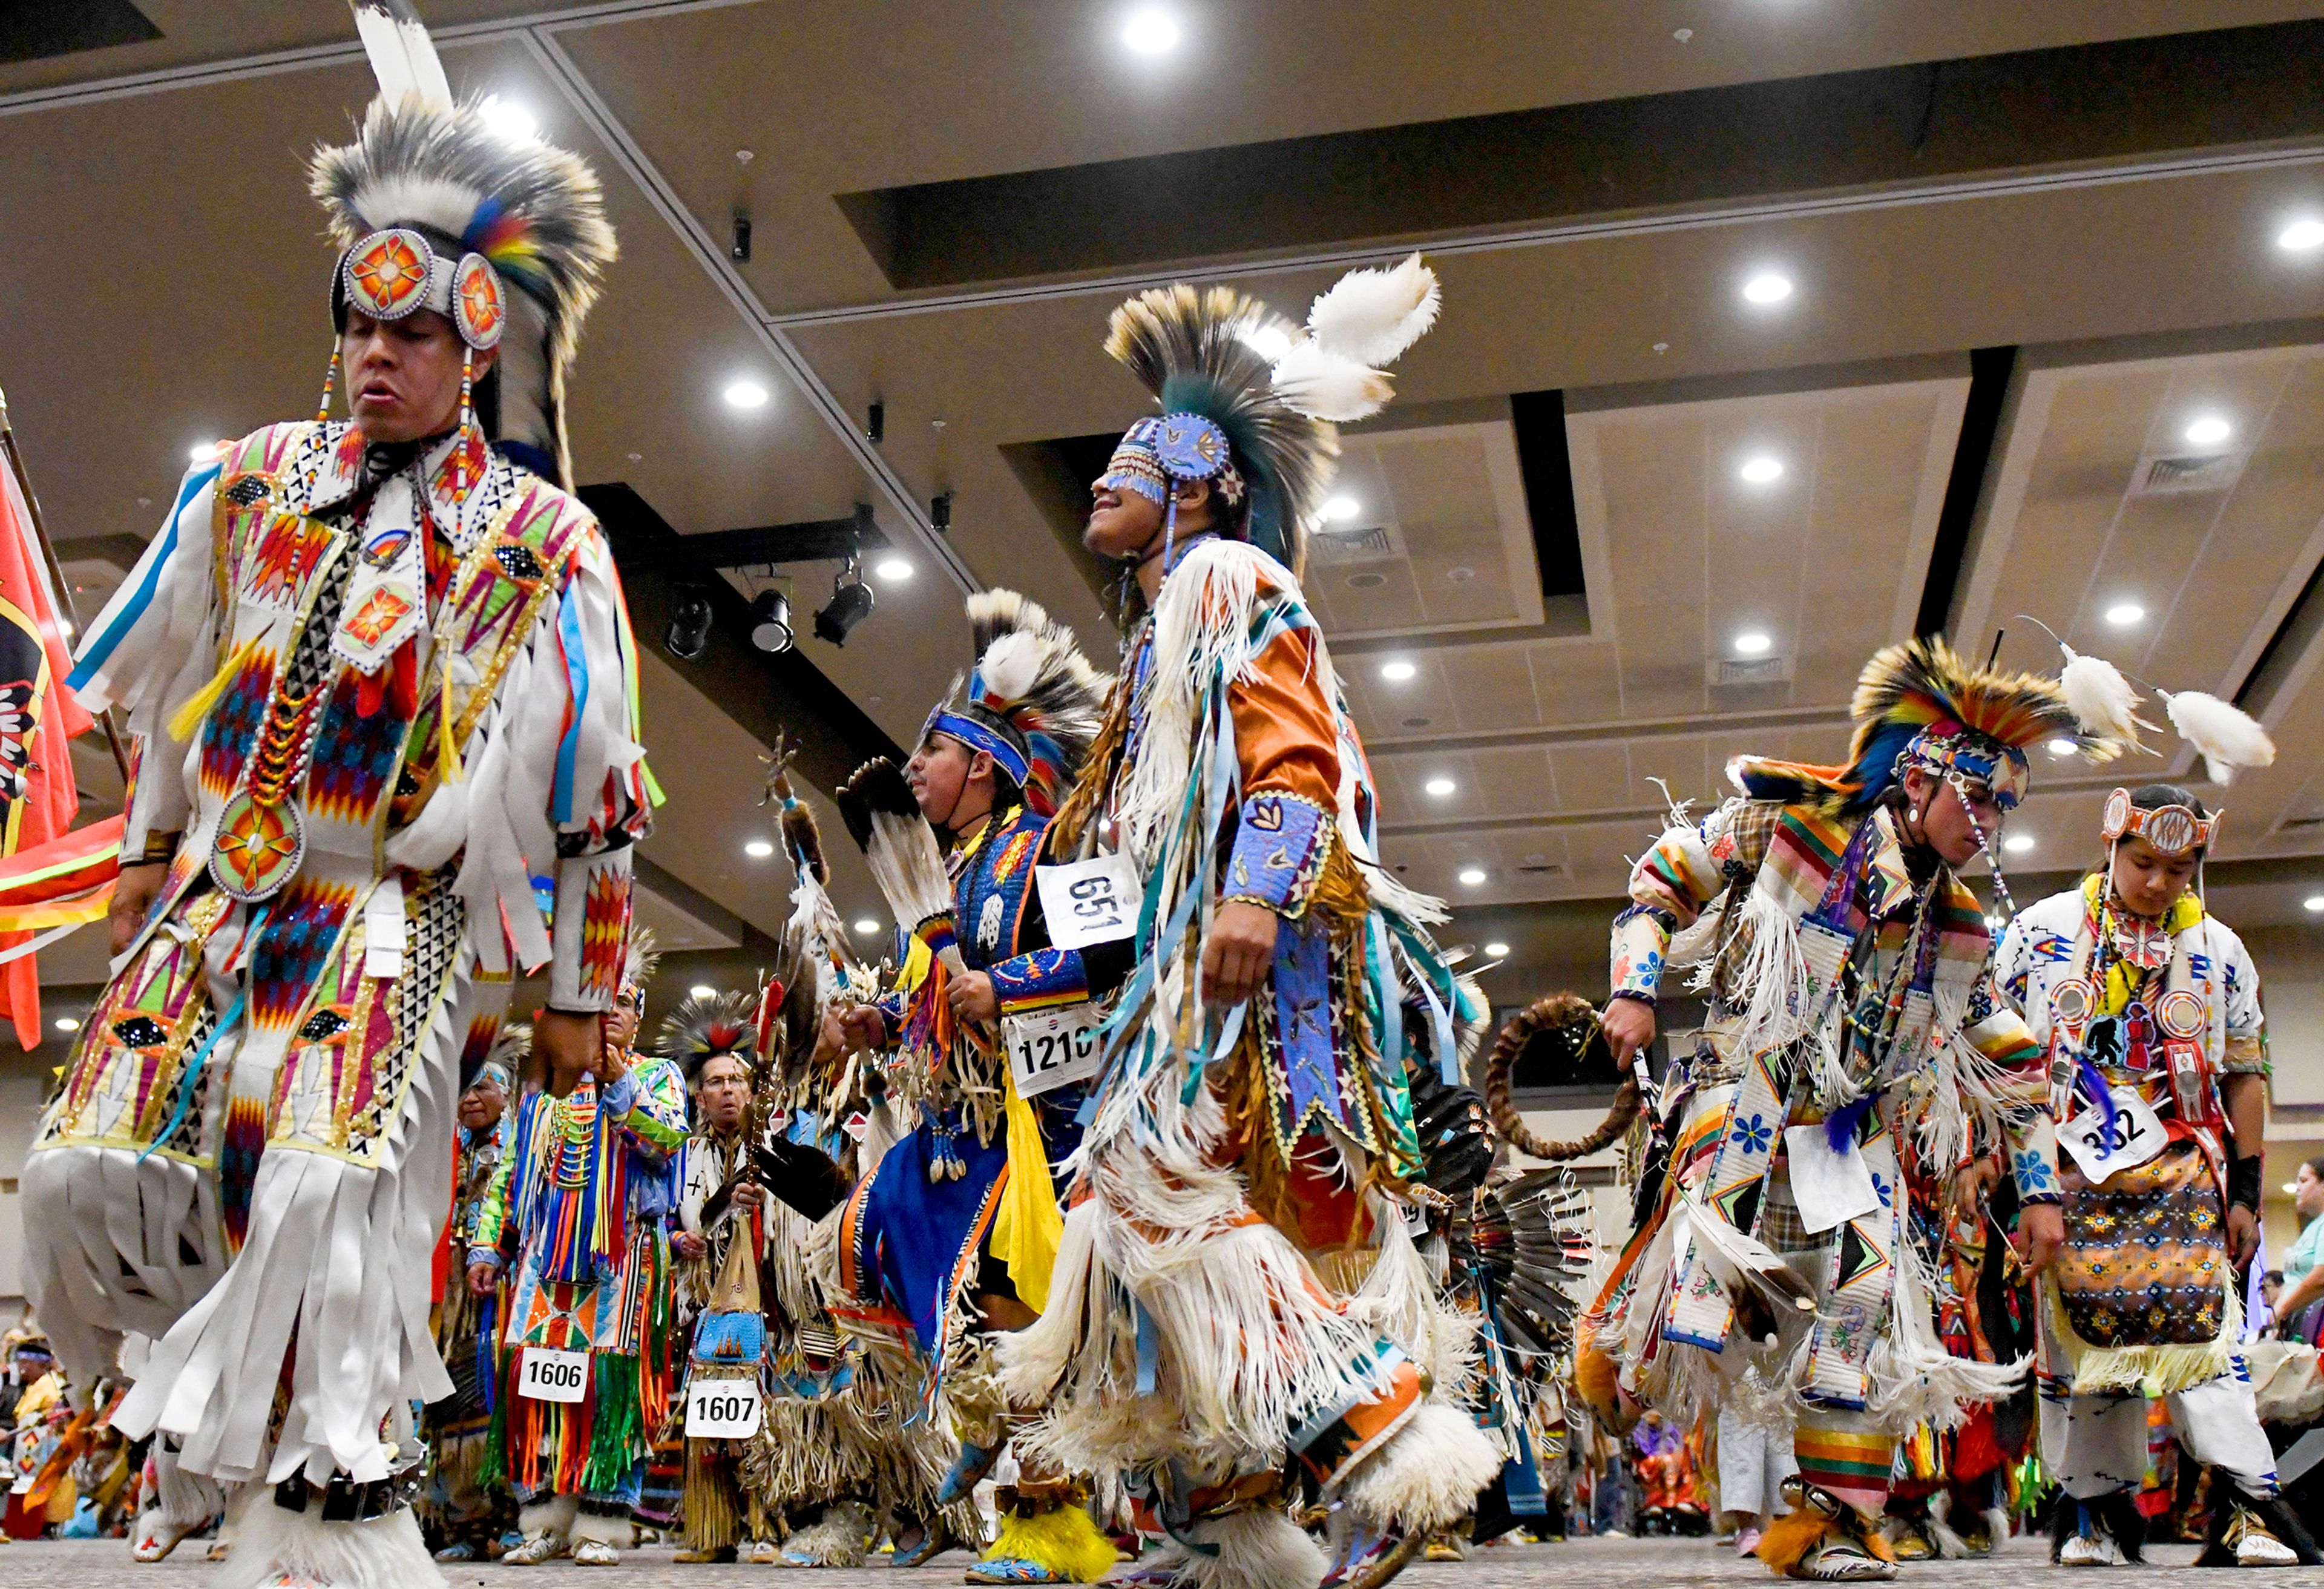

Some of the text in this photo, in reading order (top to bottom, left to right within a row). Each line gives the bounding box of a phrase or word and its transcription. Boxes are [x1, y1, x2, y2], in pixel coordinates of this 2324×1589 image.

[1069, 877, 1122, 931] 651
[2083, 1109, 2145, 1160] 352
[530, 1361, 582, 1387] 1606
[697, 1397, 755, 1421] 1607
